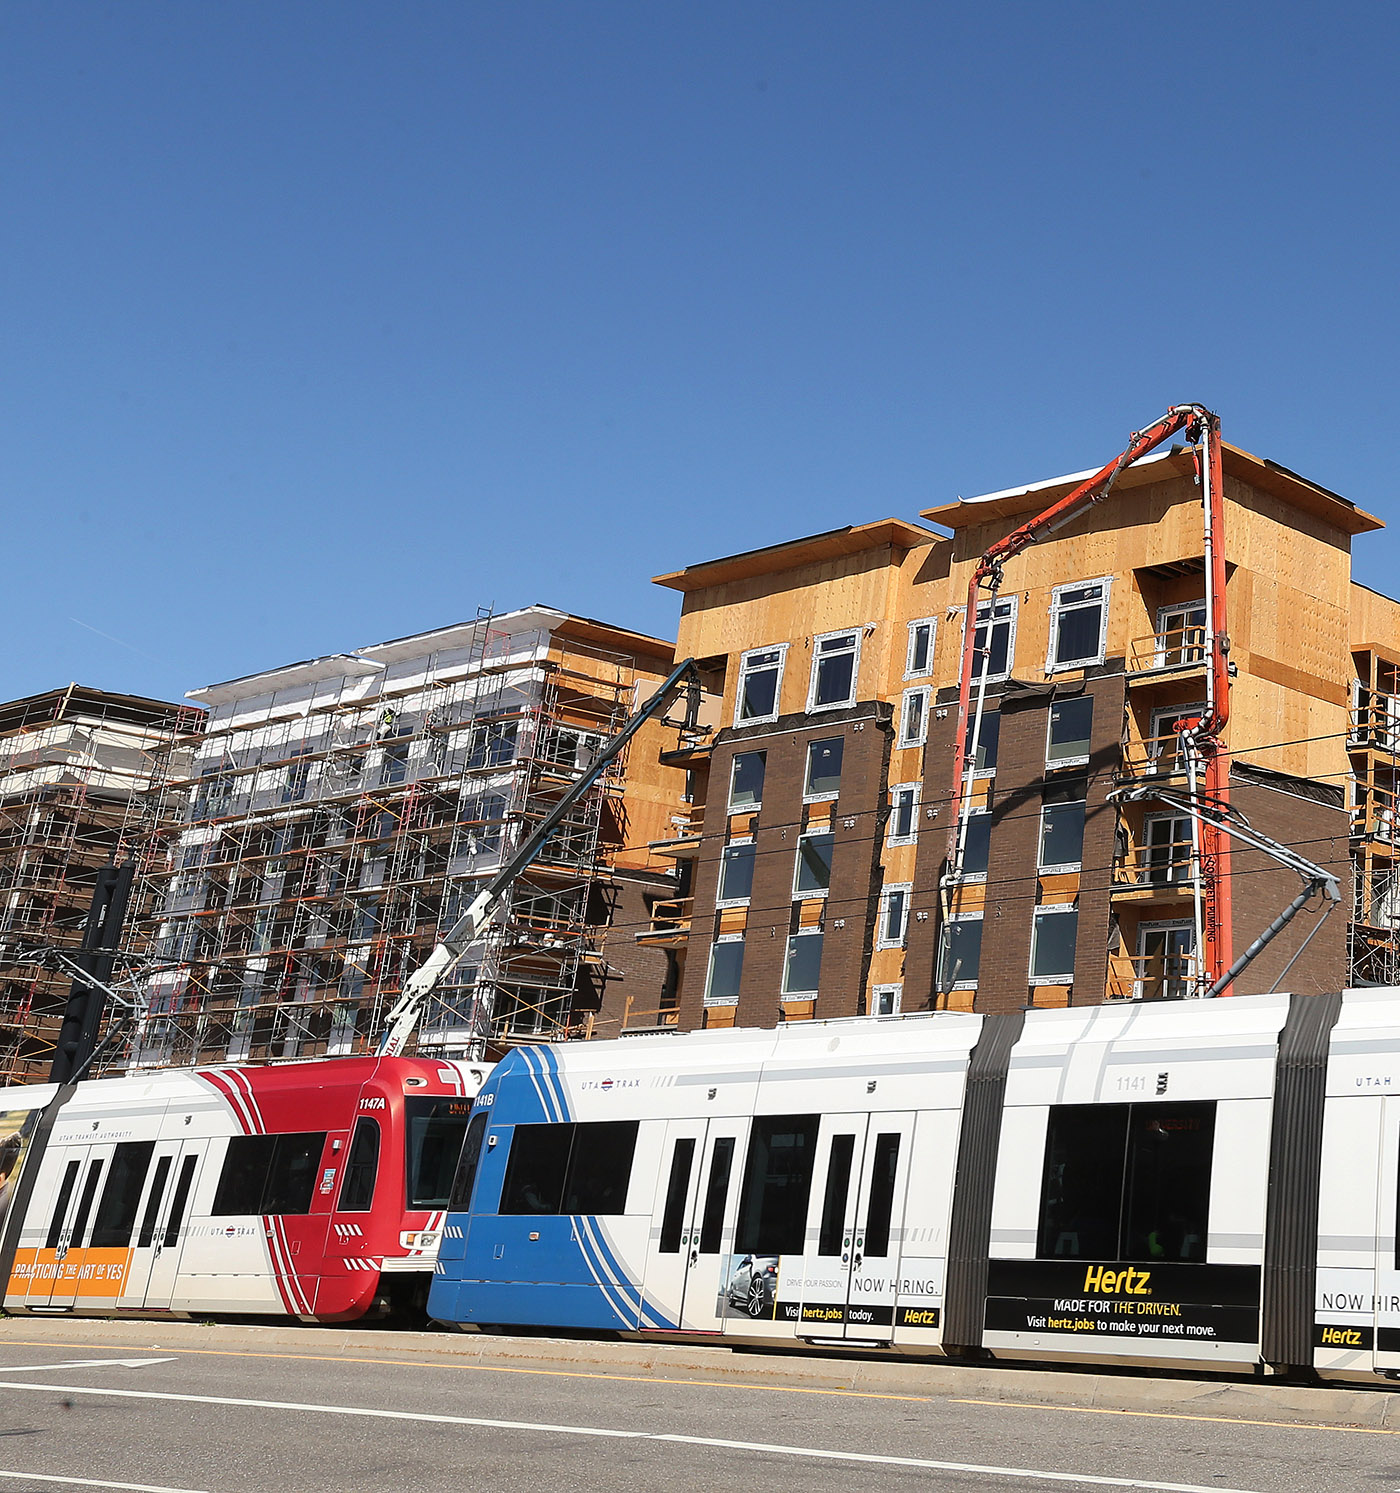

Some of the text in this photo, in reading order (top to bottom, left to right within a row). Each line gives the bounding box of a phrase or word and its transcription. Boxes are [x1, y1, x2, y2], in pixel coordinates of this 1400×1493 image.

[1207, 907, 1216, 943] PUMPING
[582, 1080, 640, 1090] UTA TRAX
[1116, 1076, 1146, 1090] 1141
[1356, 1077, 1392, 1087] UTAH
[360, 1098, 386, 1110] 1147A
[14, 1263, 64, 1280] PRACTICING
[65, 1264, 78, 1276] THE
[78, 1264, 96, 1279] ART
[106, 1264, 124, 1280] YES
[854, 1278, 938, 1295] NOW HIRING.
[1054, 1300, 1182, 1316] MADE FOR THE DRIVEN.
[1322, 1293, 1364, 1310] NOW
[786, 1306, 874, 1322] Visi hertz.jobs today.
[1026, 1316, 1216, 1336] Visit hertz.jobs to make your next move.
